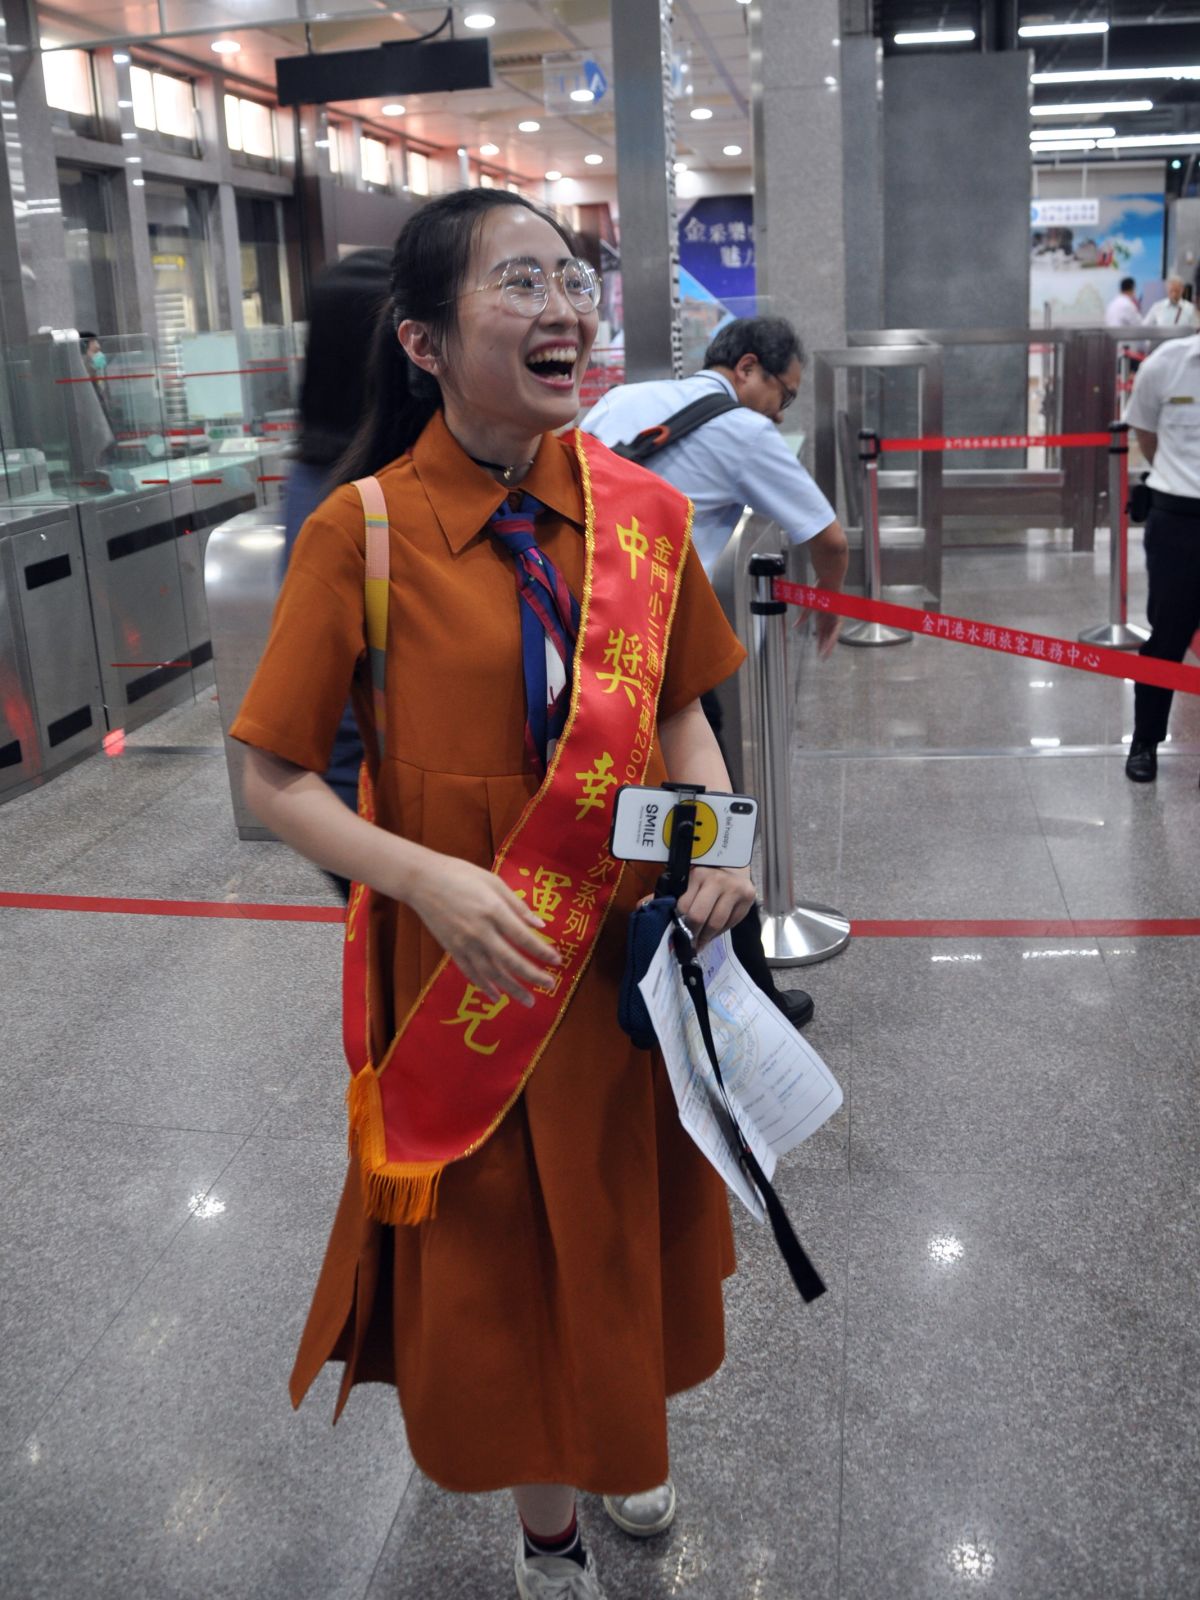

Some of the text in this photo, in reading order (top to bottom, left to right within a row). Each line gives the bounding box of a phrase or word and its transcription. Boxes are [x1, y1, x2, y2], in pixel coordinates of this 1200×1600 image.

[922, 614, 1101, 668] 金門港水頭旅客服務中心
[642, 803, 659, 848] SMILE
